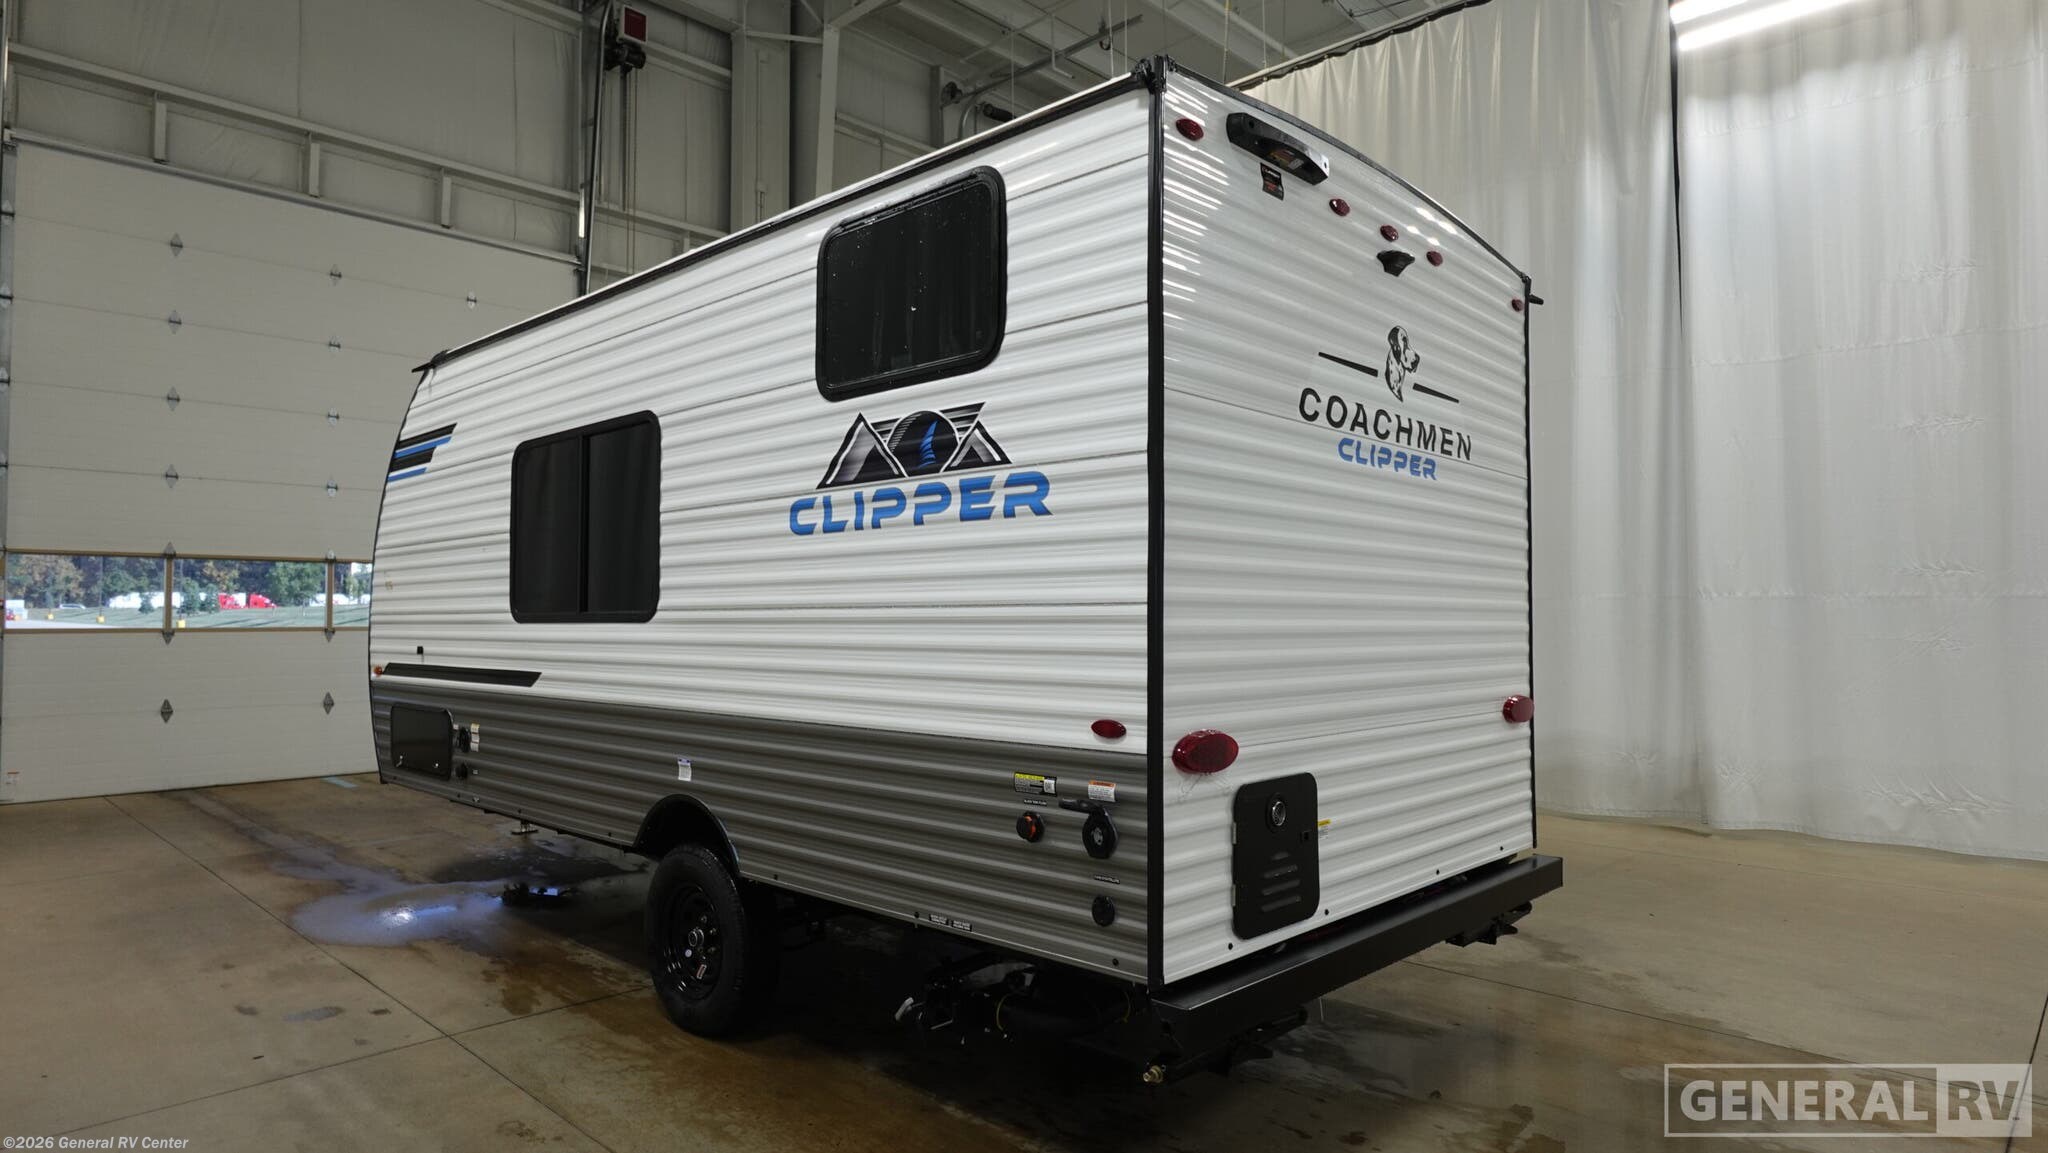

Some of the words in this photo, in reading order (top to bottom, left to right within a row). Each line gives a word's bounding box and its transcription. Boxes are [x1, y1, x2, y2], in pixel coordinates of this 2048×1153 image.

[1299, 387, 1472, 461] COACHMEN
[1337, 437, 1437, 481] CLIPPER
[789, 471, 1053, 536] CLIPPER
